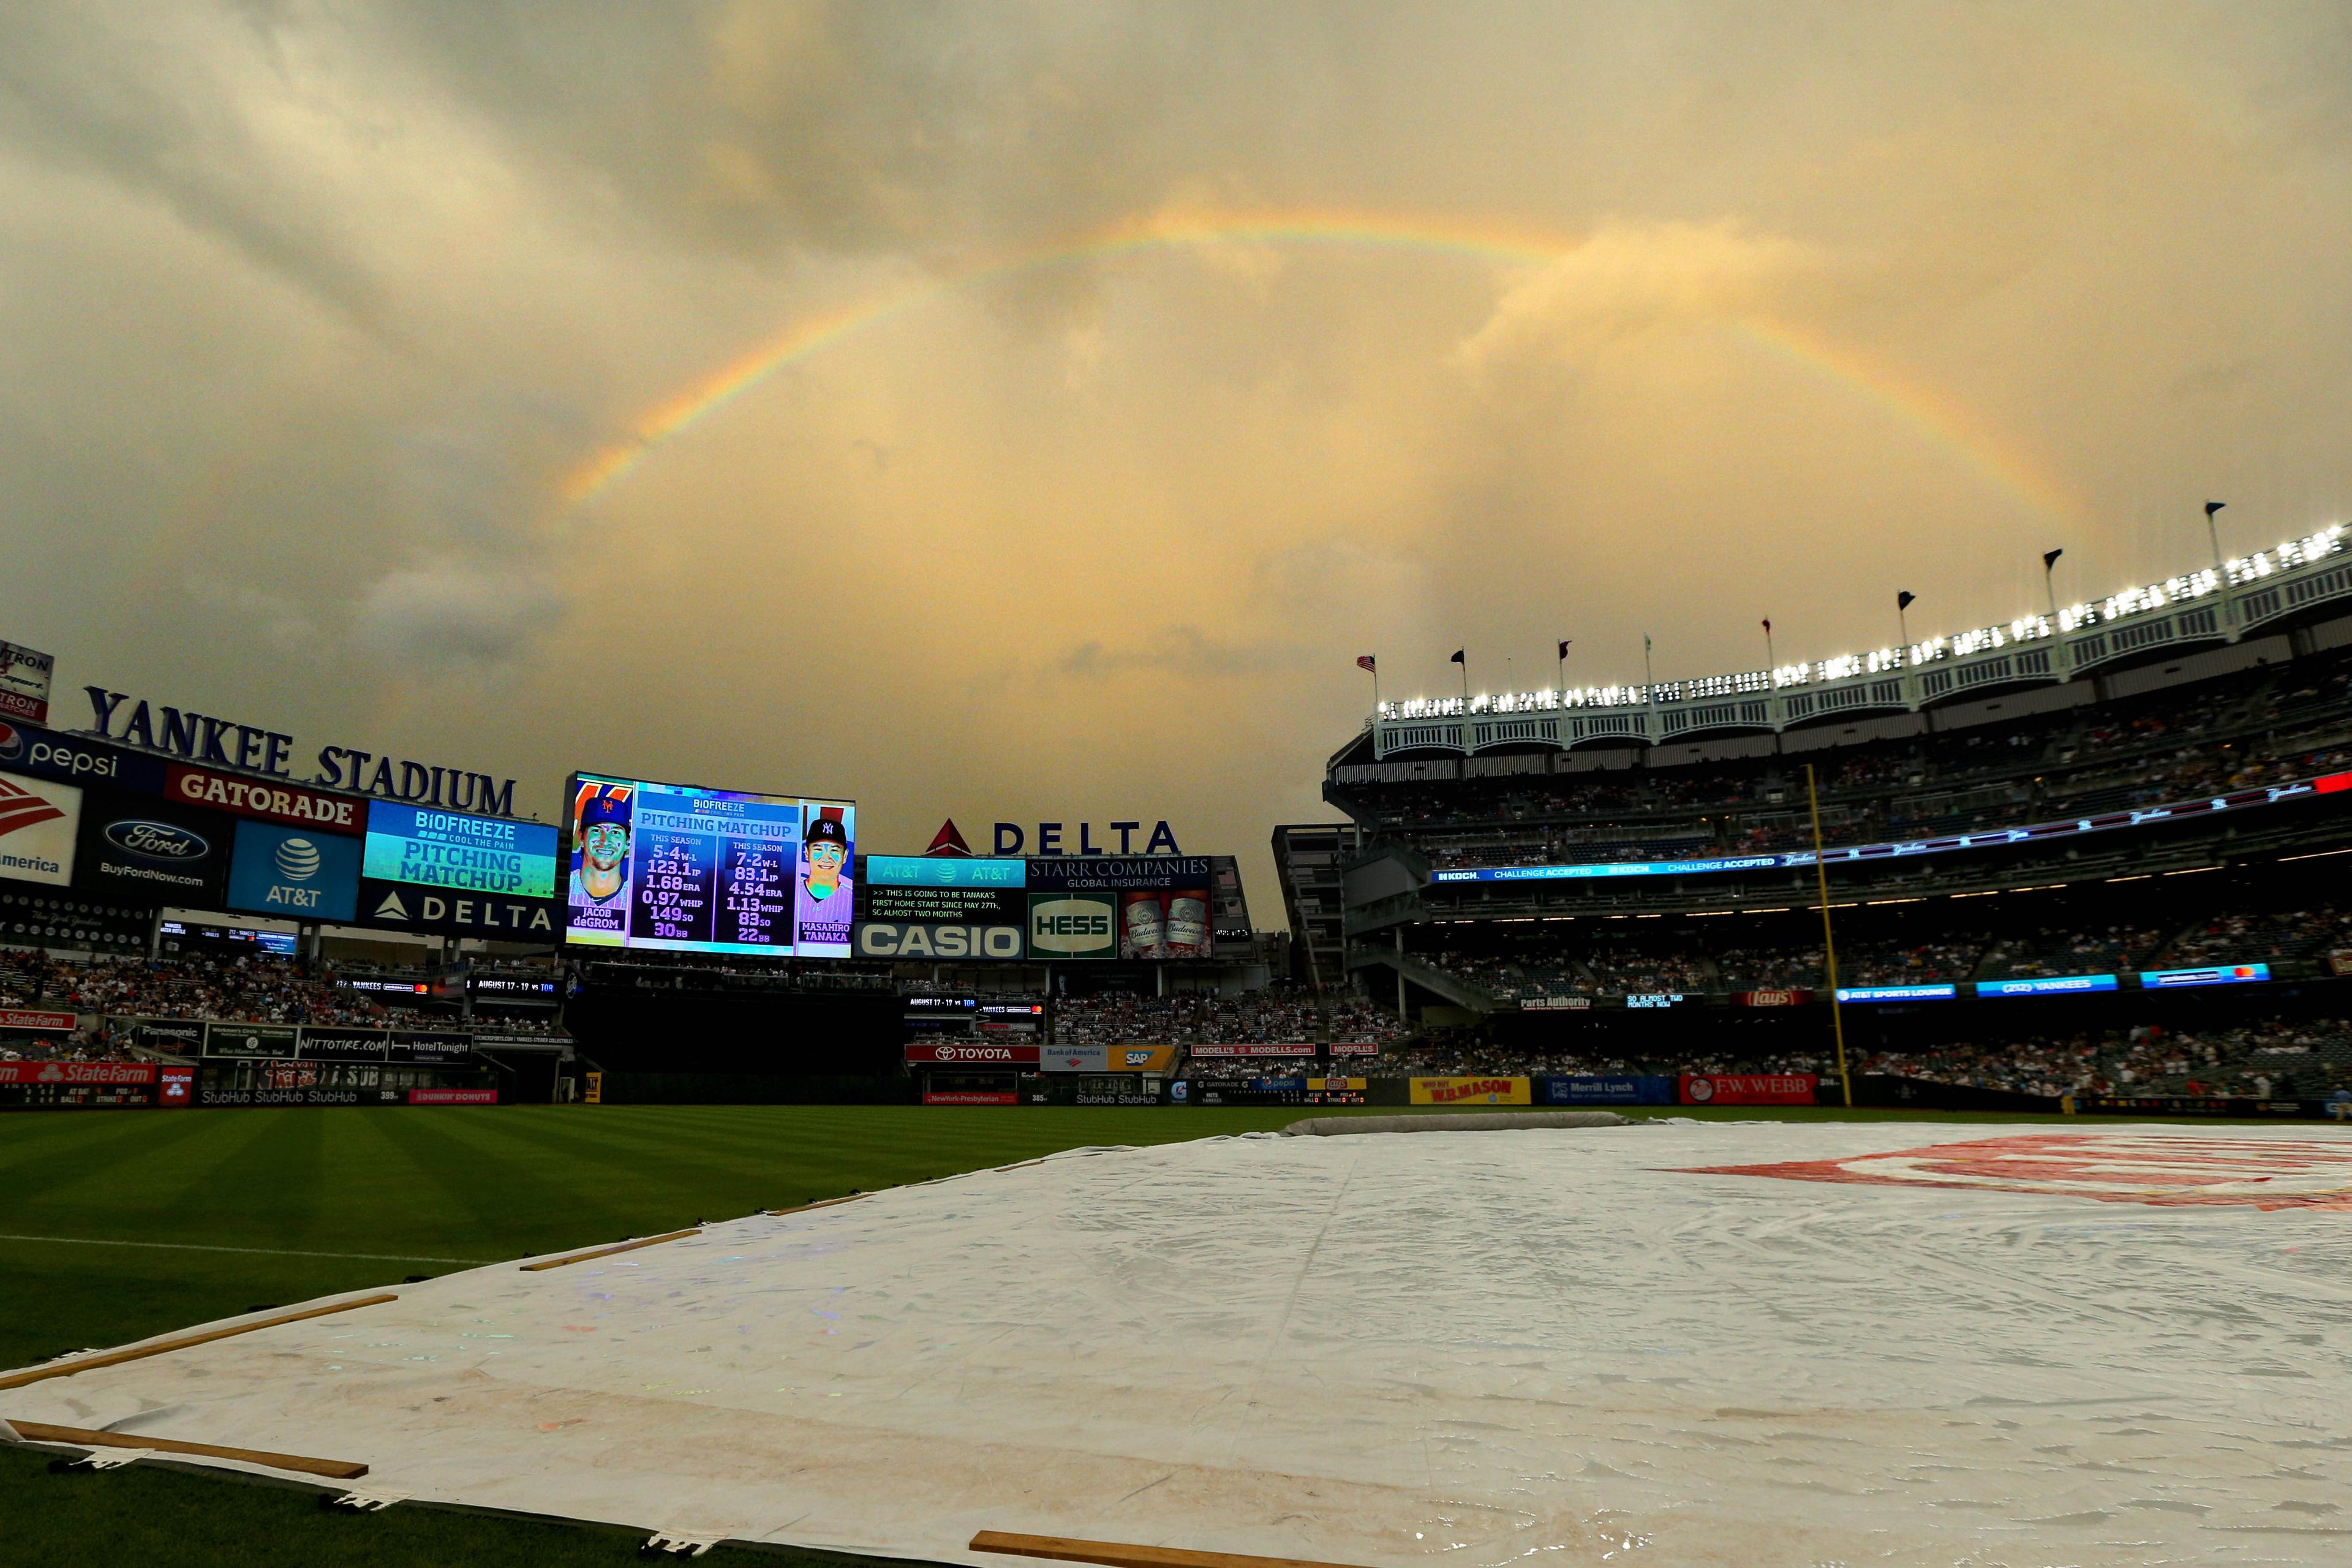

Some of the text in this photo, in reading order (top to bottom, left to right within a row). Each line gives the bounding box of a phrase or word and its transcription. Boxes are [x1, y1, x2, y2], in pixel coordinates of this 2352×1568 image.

[83, 685, 516, 817] YANKEE STADIUM
[29, 743, 117, 777] pepsi
[180, 774, 353, 826] GATORADE
[641, 813, 791, 837] PITCHING MATCHUP
[125, 824, 191, 857] Ford
[449, 834, 514, 850] COOL THE PAIN
[650, 834, 702, 845] THIS SEASON
[993, 821, 1179, 854] DELTA
[653, 844, 697, 862] 5-4 W-L
[733, 842, 783, 853] THIS SEASON
[0, 853, 59, 873] merica
[404, 841, 521, 873] PITCHING
[736, 852, 778, 868] 7-2 W-L
[647, 859, 692, 876] 123.1
[883, 864, 1011, 880] AT&T AT&T
[1030, 859, 1208, 877] STARR COMPANIES
[1546, 867, 1592, 877] ACCEPTED
[1668, 858, 1775, 872] CHALLENGE ACCEPTED
[100, 862, 203, 887] BuyFordNow.com
[399, 861, 522, 892] MATCHUP
[734, 866, 769, 881] 83.1
[646, 875, 682, 890] 1.68
[729, 881, 765, 896] 4.54
[1068, 878, 1171, 888] GLOBAL INSURANCE
[266, 886, 321, 908] AT&T
[642, 890, 703, 908] 0.97 WHIP
[727, 897, 760, 911] 1.13
[422, 896, 552, 931] DELTA
[582, 907, 611, 918] JACOB
[650, 906, 682, 921] 149
[739, 912, 760, 925] 83
[573, 916, 619, 929] deGROM
[654, 922, 676, 937] 30
[802, 922, 850, 932] MASAHIRO
[1037, 915, 1108, 935] HESS
[738, 927, 758, 941] 22
[804, 931, 848, 941] TANAKA
[861, 924, 1021, 957] CASIO
[353, 981, 382, 990] YANKEES
[478, 979, 505, 989] AUGUST
[507, 981, 515, 990] 17
[521, 982, 529, 990] 19
[540, 983, 553, 992] TOR
[1850, 987, 1953, 999] AT&T SPORTS LOUNGE
[2002, 980, 2092, 993] (212) YANKEES
[1547, 997, 1591, 1008] Authority
[142, 1025, 198, 1038] Panasonic
[300, 1036, 386, 1052] NITTOTIRE.COM
[1333, 1044, 1374, 1053] MODELL'S
[957, 1048, 1012, 1059] TOYOTA
[1126, 1053, 1148, 1064] SAP
[1273, 1079, 1295, 1088] pepsi
[1570, 1082, 1634, 1093] Merrill Lynch
[1716, 1078, 1807, 1093] F.W. WEBB
[202, 1090, 357, 1104] StubHub StubHub StubHub
[380, 1091, 395, 1101] 399
[454, 1092, 490, 1101] DONUTS
[1076, 1095, 1156, 1104] StubHub StubHub
